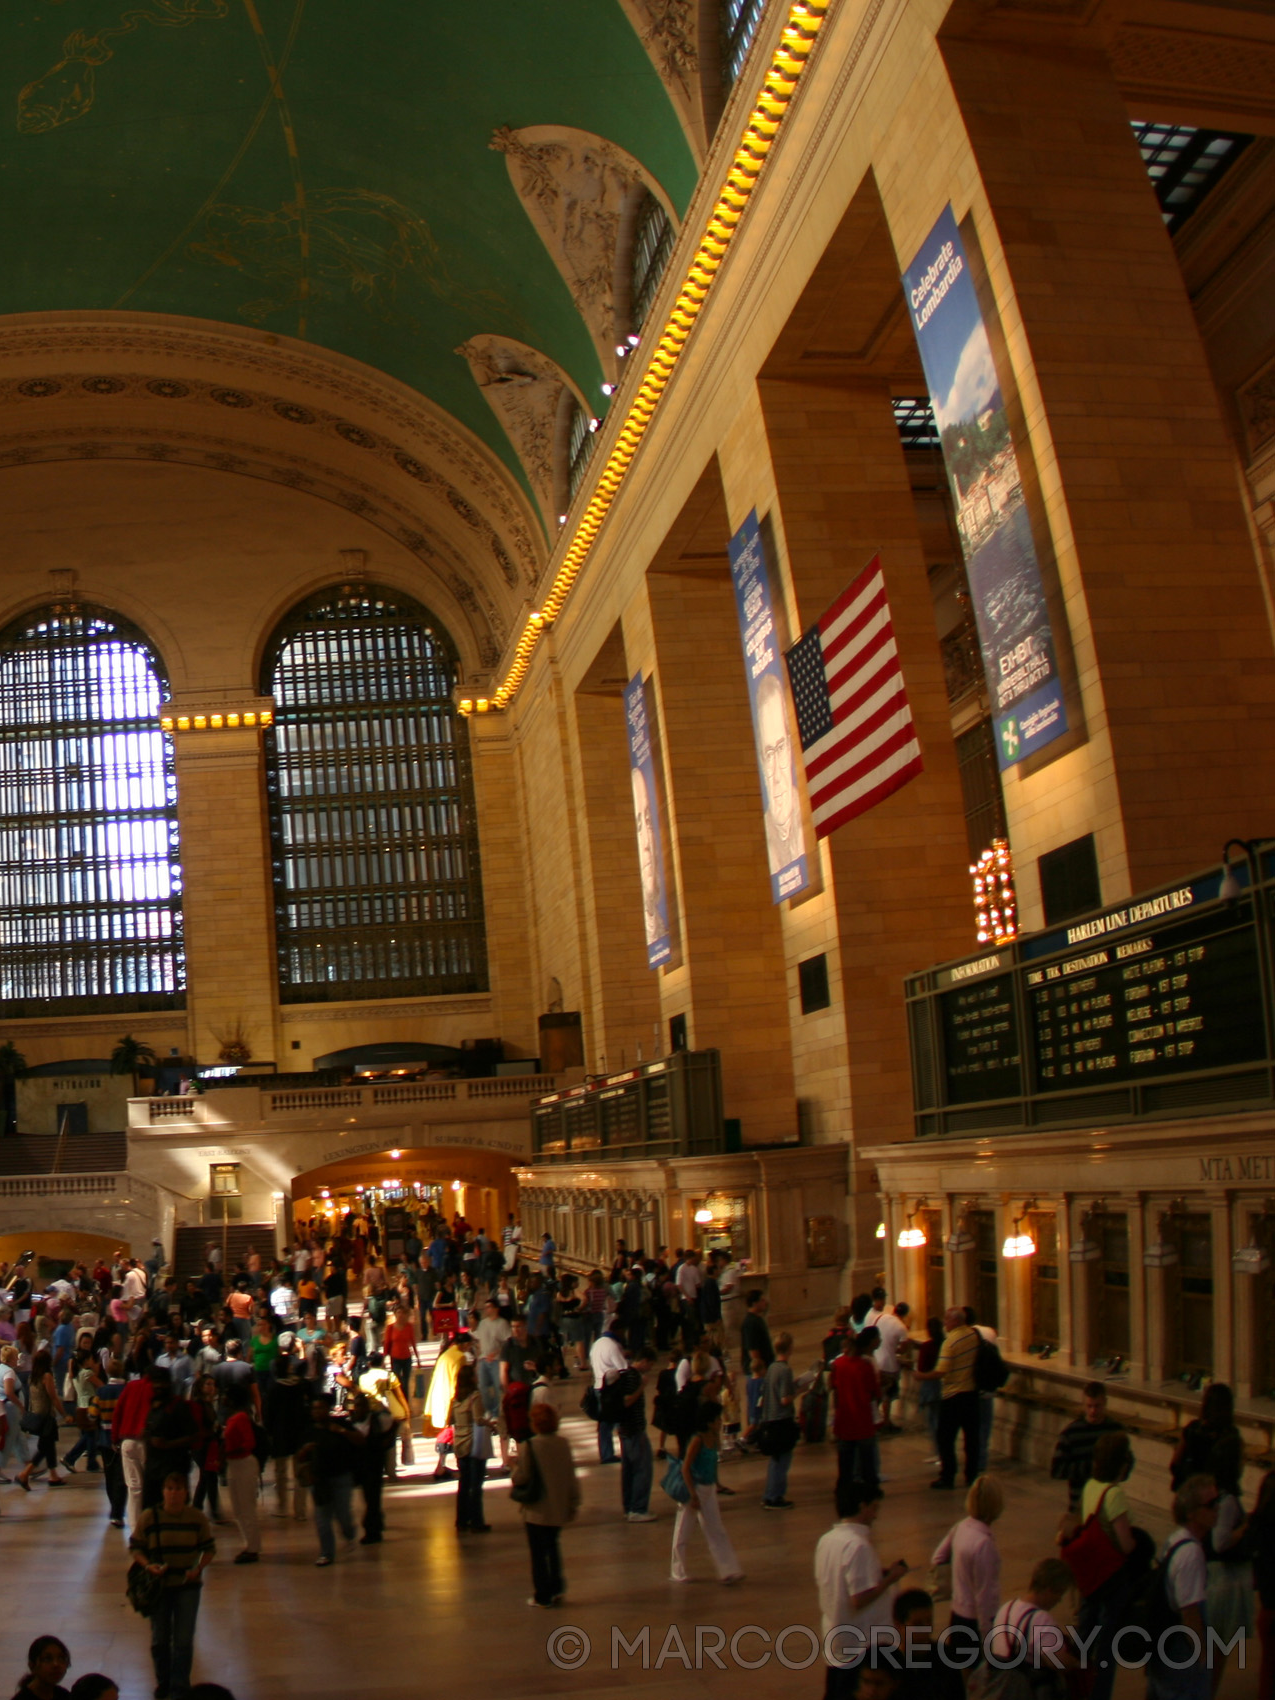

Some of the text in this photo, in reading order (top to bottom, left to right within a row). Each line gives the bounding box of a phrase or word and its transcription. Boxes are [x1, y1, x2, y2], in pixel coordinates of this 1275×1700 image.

[911, 240, 954, 309] Celebrate
[915, 255, 964, 331] Lombardia
[999, 635, 1034, 675] EXHIBIT
[1067, 886, 1193, 945] HARLEM LINE DEPARTURES
[950, 954, 1000, 982] INFORMATION
[1062, 951, 1109, 975] DESTINATION
[1116, 937, 1153, 959] REMARKS
[322, 1142, 380, 1161] LEXINGTON
[435, 1135, 474, 1145] SUBWAY
[512, 1143, 525, 1152] ST
[1199, 1157, 1233, 1181] MTA
